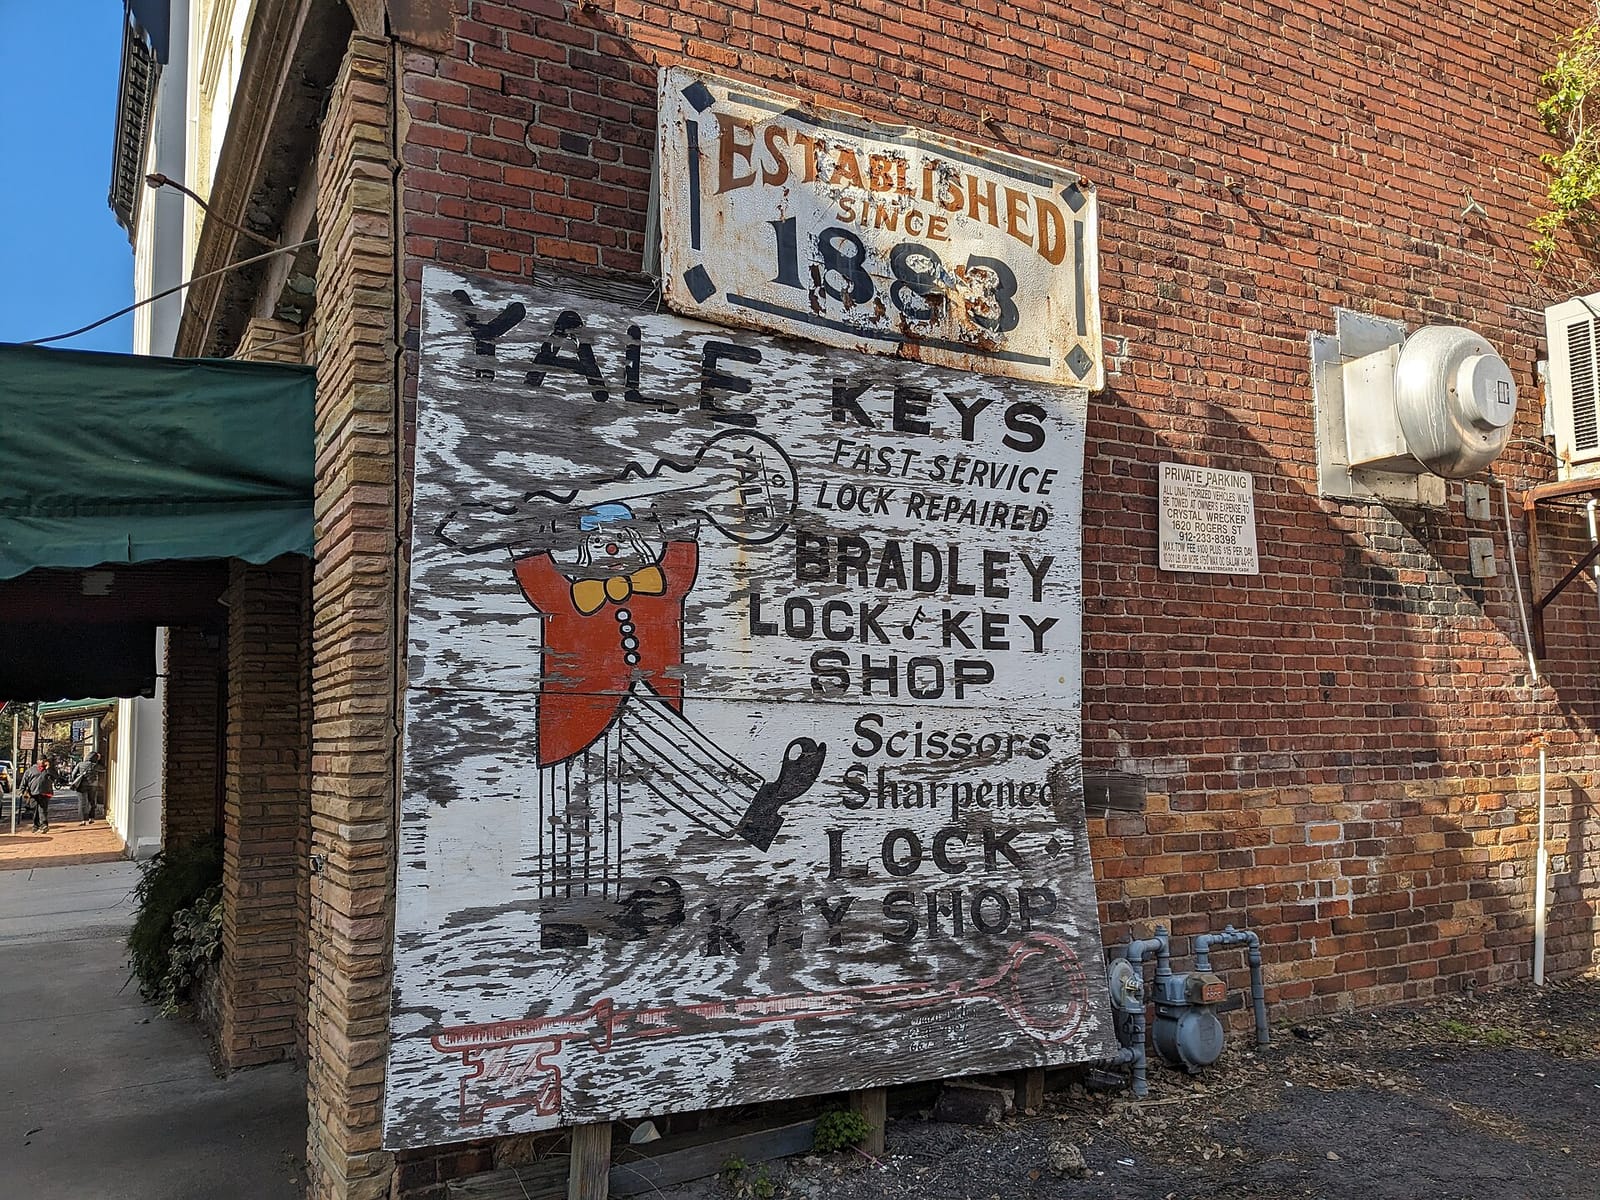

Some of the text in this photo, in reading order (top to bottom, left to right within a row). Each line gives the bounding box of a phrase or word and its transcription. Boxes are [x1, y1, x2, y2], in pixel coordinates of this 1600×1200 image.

[713, 111, 1068, 266] ESTABLISHED
[836, 197, 951, 242] SINCE
[767, 216, 1020, 333] 1883
[451, 289, 1048, 453] YALE KEYS
[832, 439, 1058, 495] FAST SERVICE
[1164, 467, 1203, 483] PRIVATE
[1206, 472, 1247, 489] PARKING
[816, 481, 1050, 532] LOCK REPAIRED
[1162, 496, 1170, 506] BE
[1220, 502, 1241, 514] EXPENSE
[1243, 504, 1250, 515] TO
[1163, 485, 1173, 496] ALL
[1174, 486, 1212, 500] UNAUTHORIZED
[1212, 490, 1236, 503] VEHICLES
[1167, 508, 1247, 525] CRYSTAL WRECKER
[1172, 520, 1243, 535] 1620 ROGERS ST
[1178, 531, 1237, 545] 912-233-8398
[1186, 543, 1196, 553] FEE
[1232, 546, 1242, 556] PER
[795, 529, 1056, 603] BRADLEY
[749, 592, 1060, 653] LOCK KEY
[810, 649, 995, 700] SHOP
[851, 713, 1051, 759] Scissors
[824, 826, 1034, 880] LOCK
[882, 887, 1058, 943] SHOP
